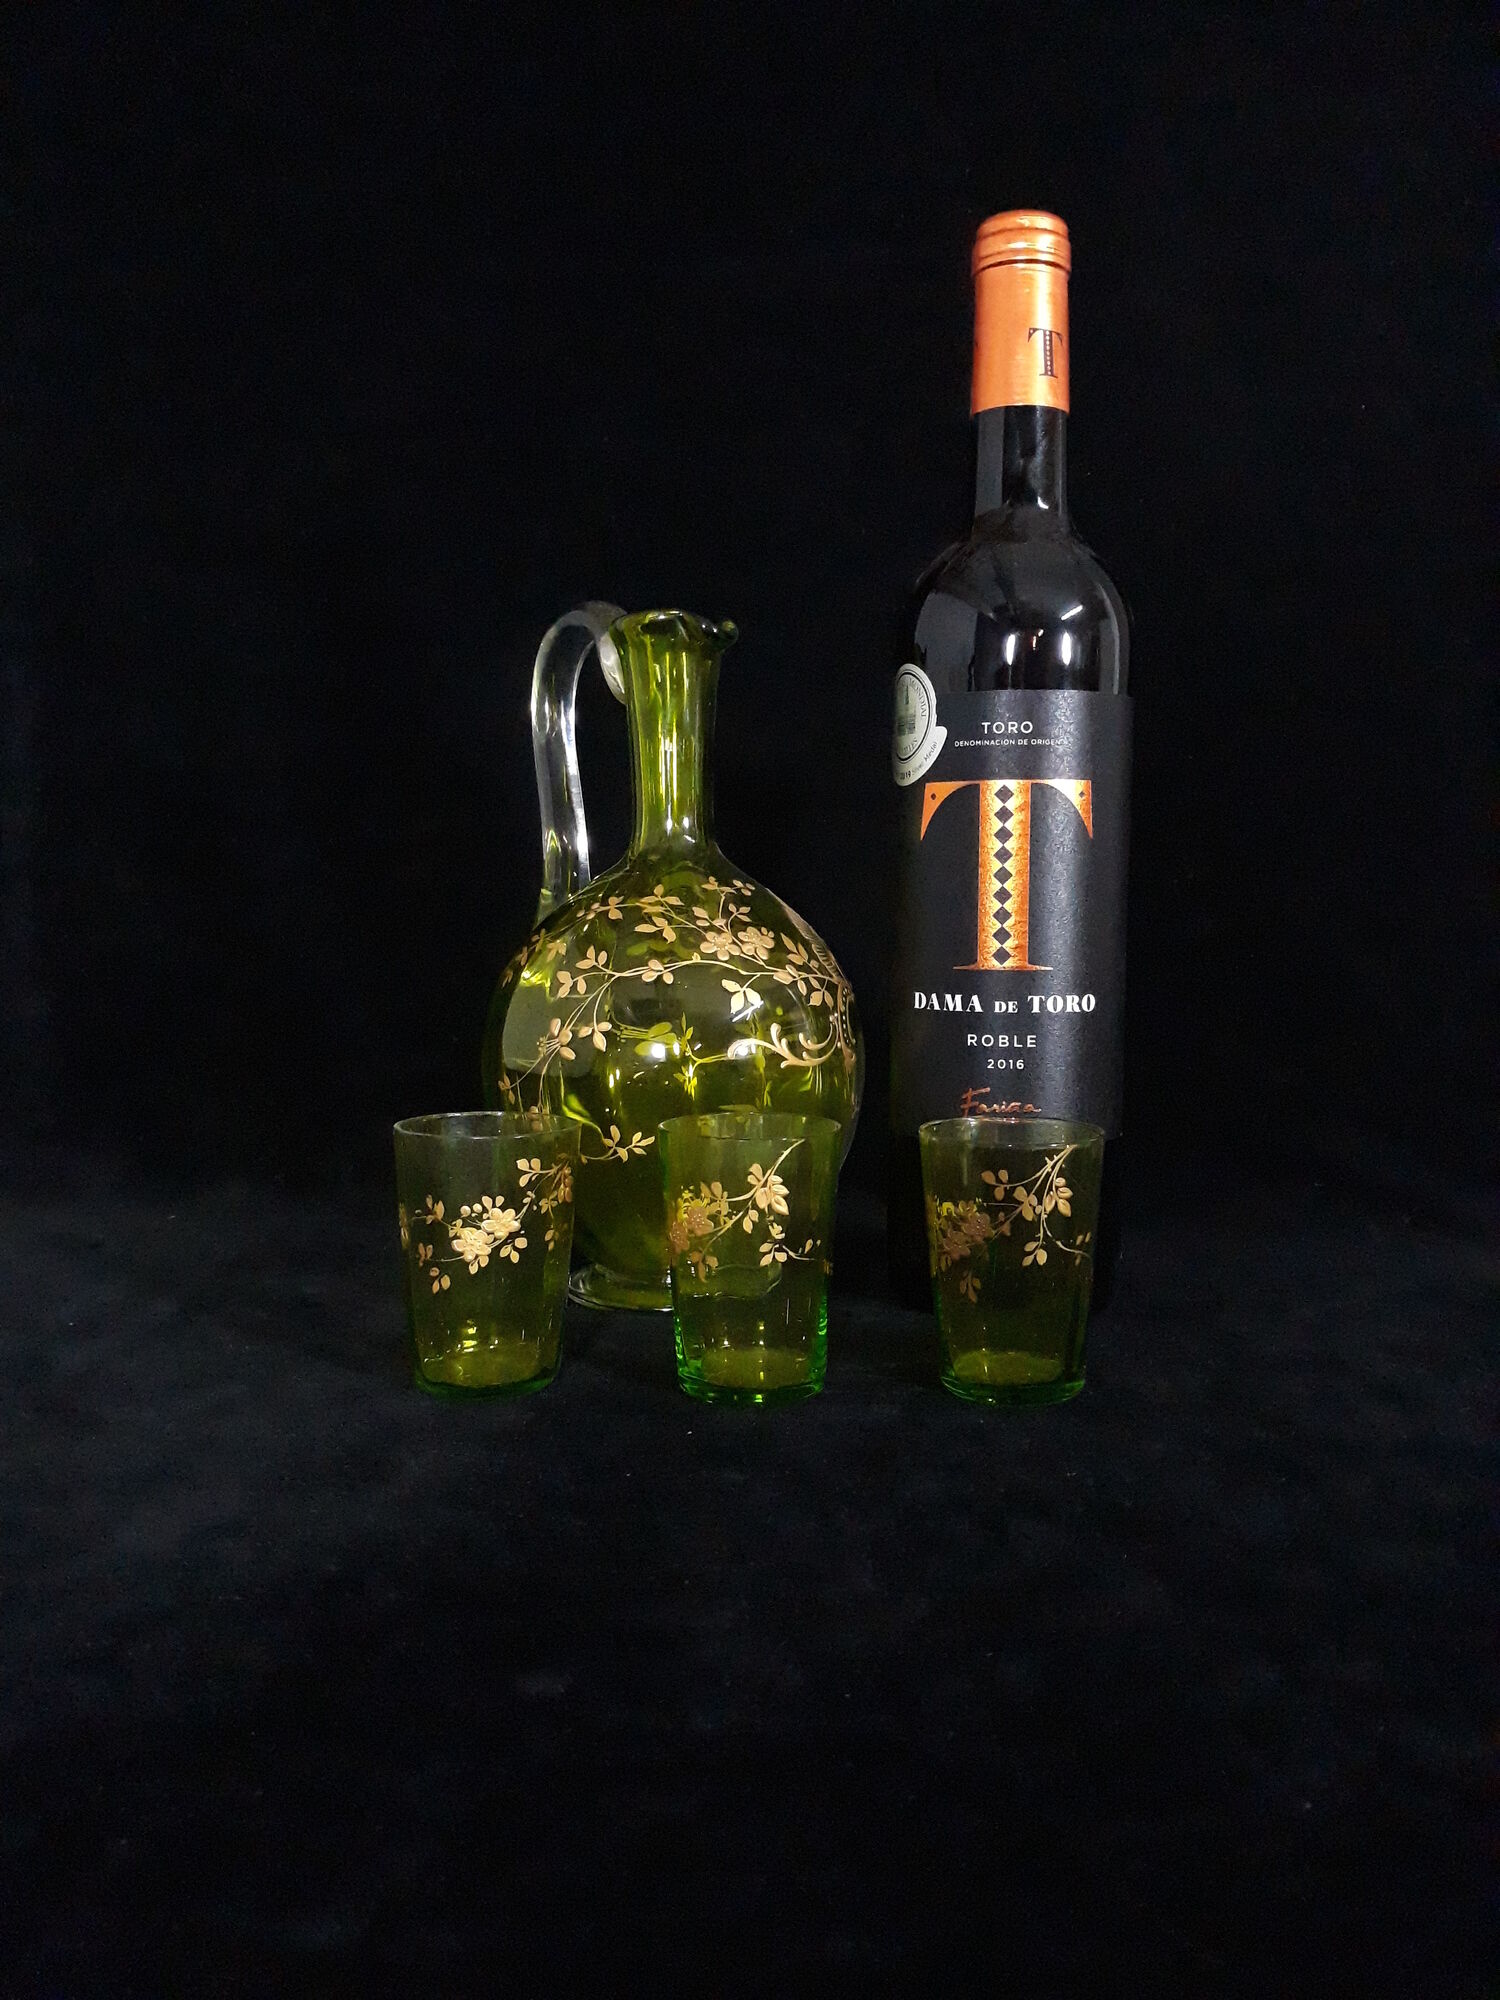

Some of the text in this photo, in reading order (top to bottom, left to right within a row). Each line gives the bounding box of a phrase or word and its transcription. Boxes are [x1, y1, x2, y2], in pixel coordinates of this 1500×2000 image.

[1028, 327, 1063, 378] T
[981, 721, 1033, 734] TORO
[1017, 738, 1029, 746] DE
[920, 779, 1094, 971] T
[913, 991, 1096, 1014] DAMA DE TORO
[967, 1034, 1037, 1048] ROBLE
[986, 1059, 1025, 1070] 2016
